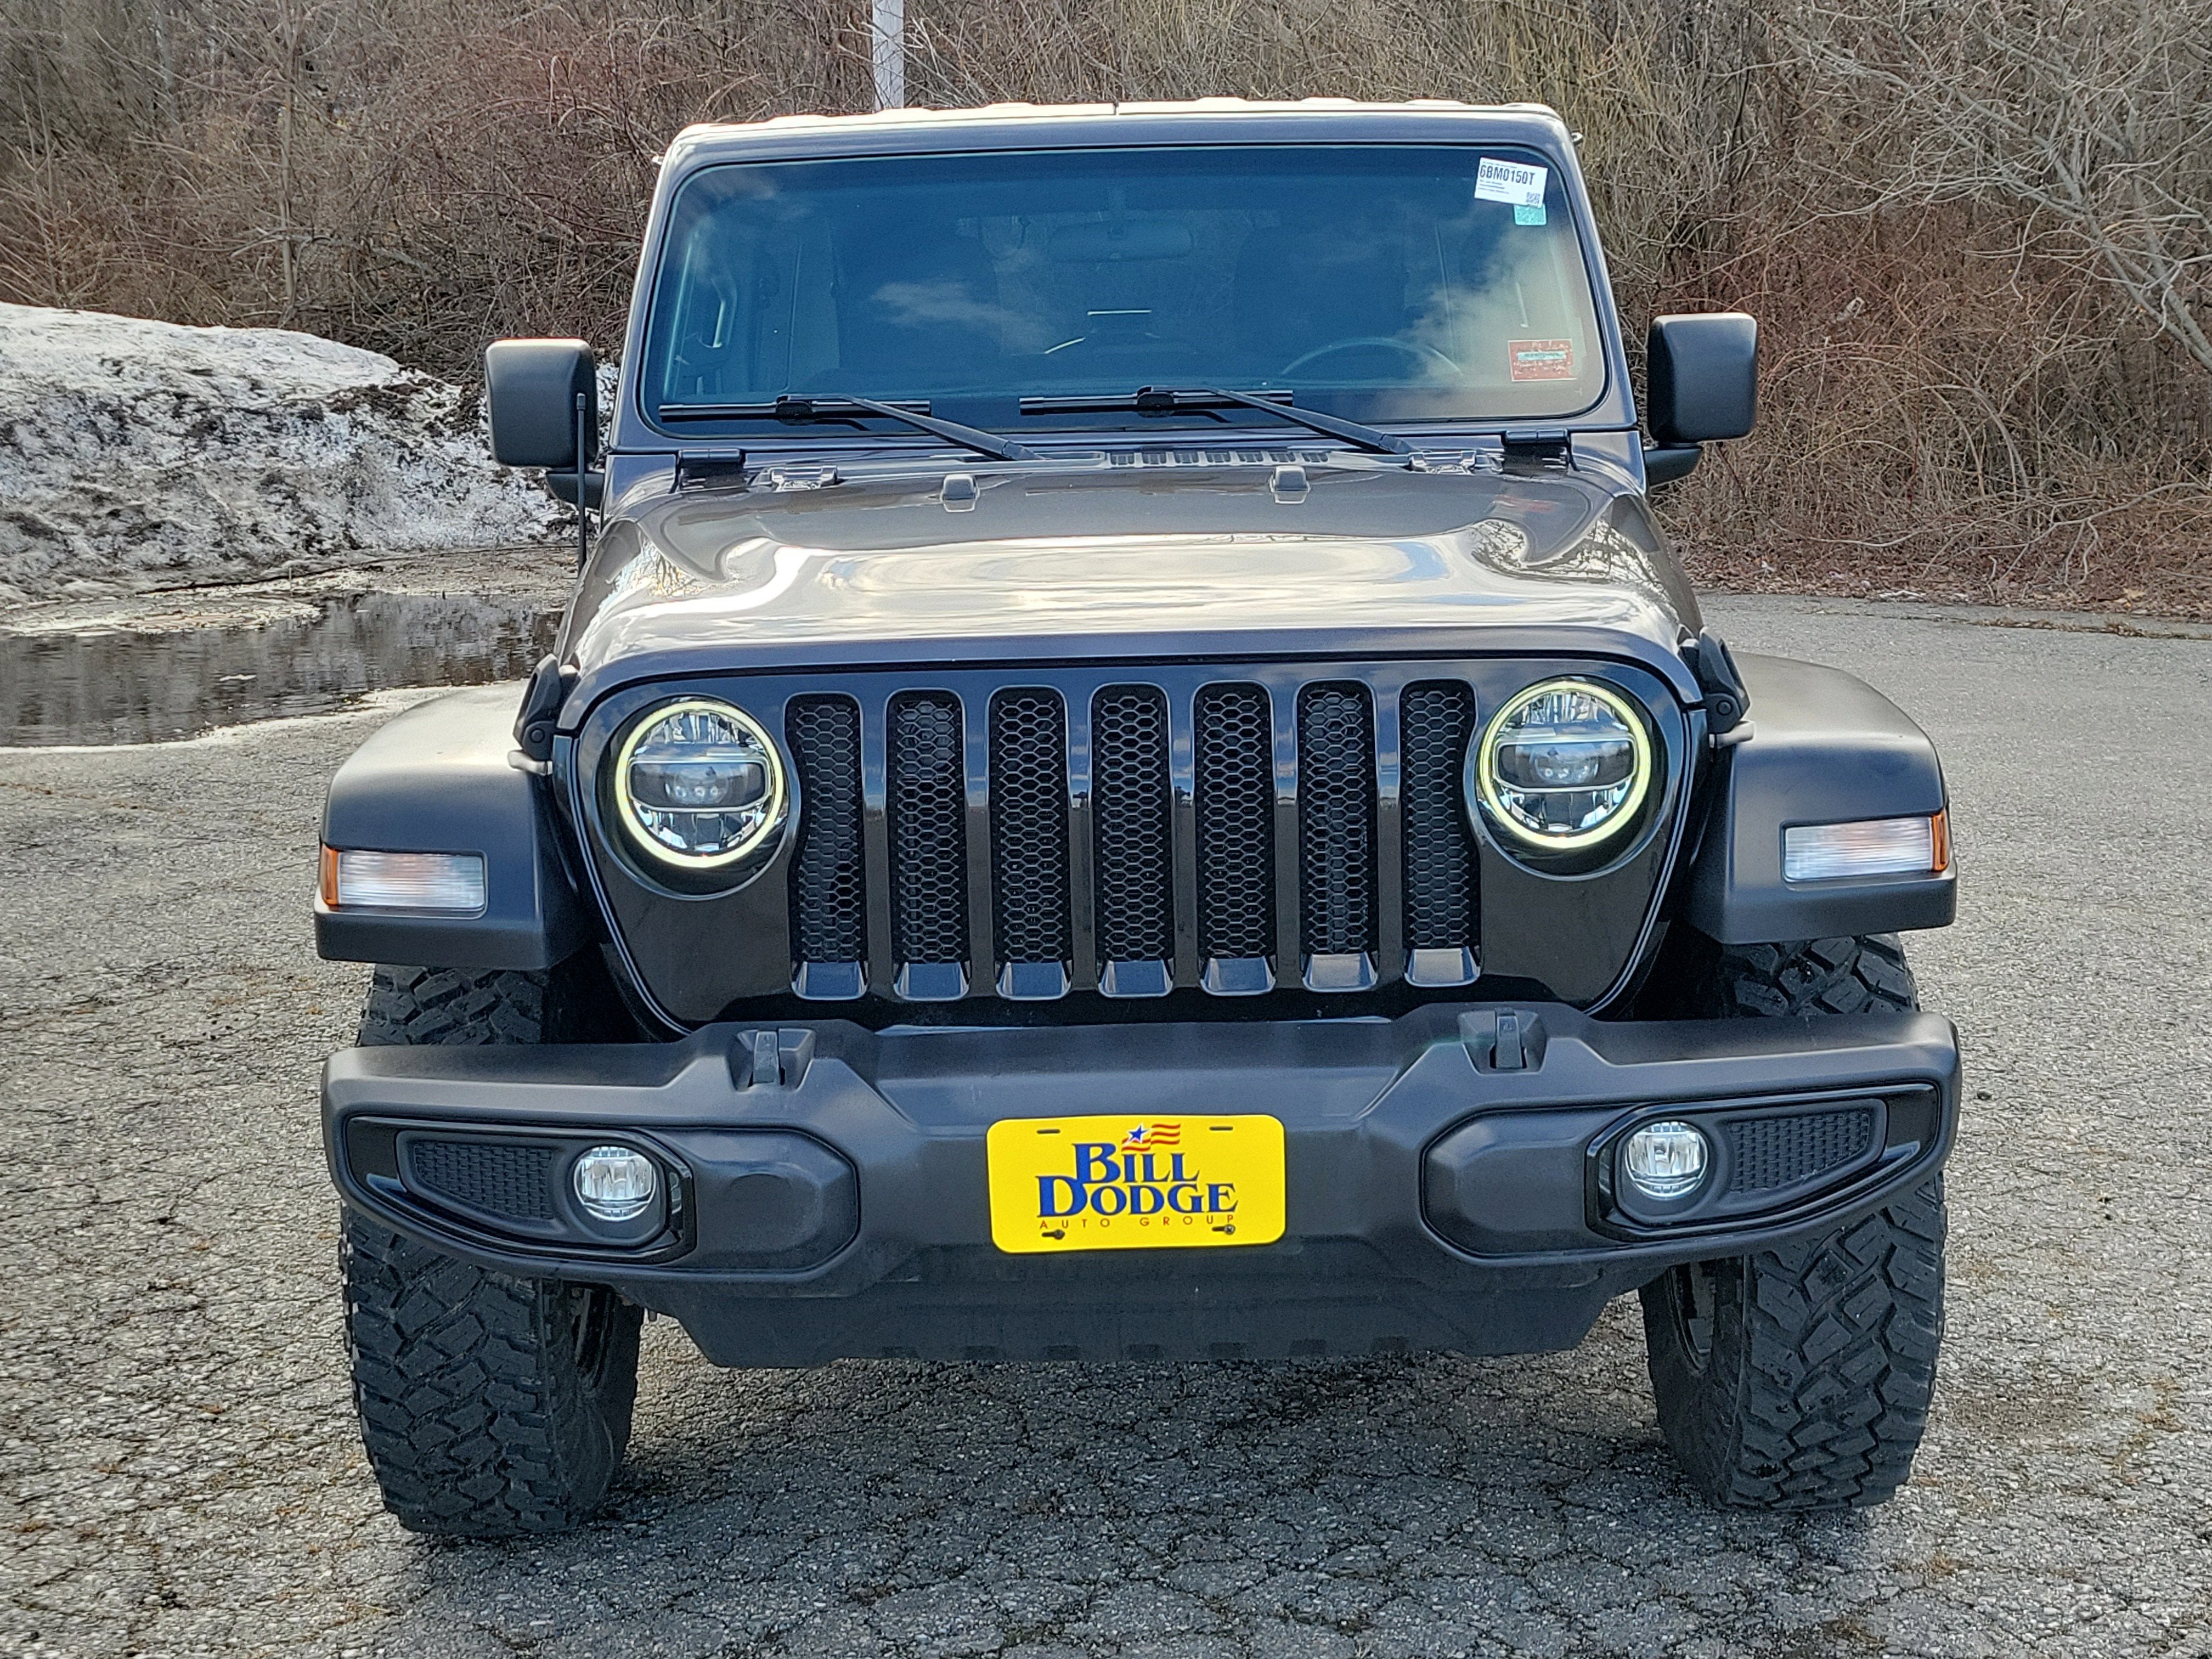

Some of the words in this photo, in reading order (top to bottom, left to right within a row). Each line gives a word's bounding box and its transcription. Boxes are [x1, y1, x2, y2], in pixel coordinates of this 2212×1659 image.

[1073, 1143, 1200, 1183] BILL
[1036, 1176, 1238, 1217] DODGE
[1040, 1218, 1110, 1229] AUTO
[1140, 1215, 1234, 1227] GROUP
